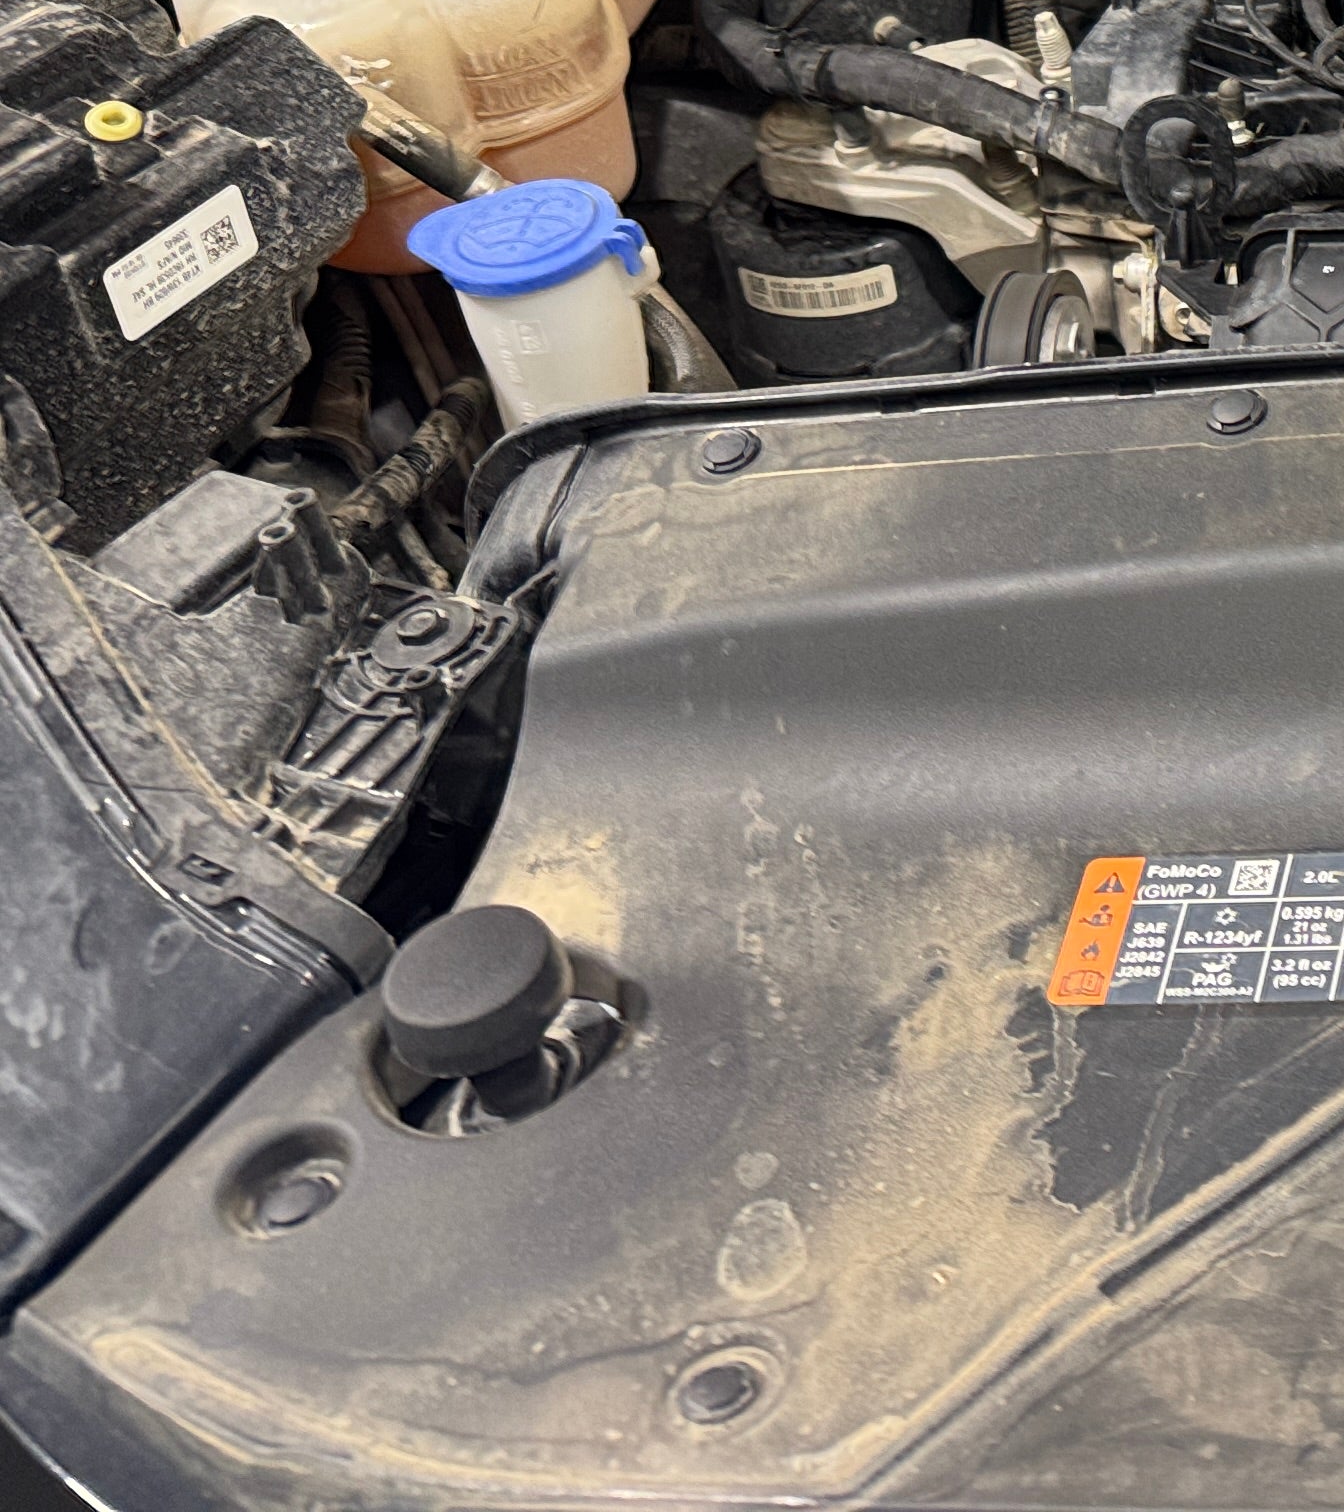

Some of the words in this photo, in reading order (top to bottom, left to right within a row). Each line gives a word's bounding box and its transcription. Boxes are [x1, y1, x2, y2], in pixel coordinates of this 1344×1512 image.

[1147, 864, 1222, 878] FoMoCo
[1303, 870, 1339, 884] 2.0L
[1137, 884, 1194, 900] (GWP
[1196, 883, 1216, 899] 4)
[1281, 906, 1323, 920] 0.595
[1324, 906, 1344, 922] kg
[1133, 922, 1169, 934] SAE
[1292, 921, 1308, 932] 21
[1310, 922, 1328, 932] oz
[1127, 937, 1165, 949] J639
[1183, 930, 1263, 946] R-1234yf
[1271, 958, 1296, 971] 3.2
[1297, 958, 1310, 971] fl
[1311, 960, 1333, 971] oz
[1192, 972, 1232, 986] PAG
[1272, 974, 1299, 990] (95
[1300, 973, 1326, 988] cc)
